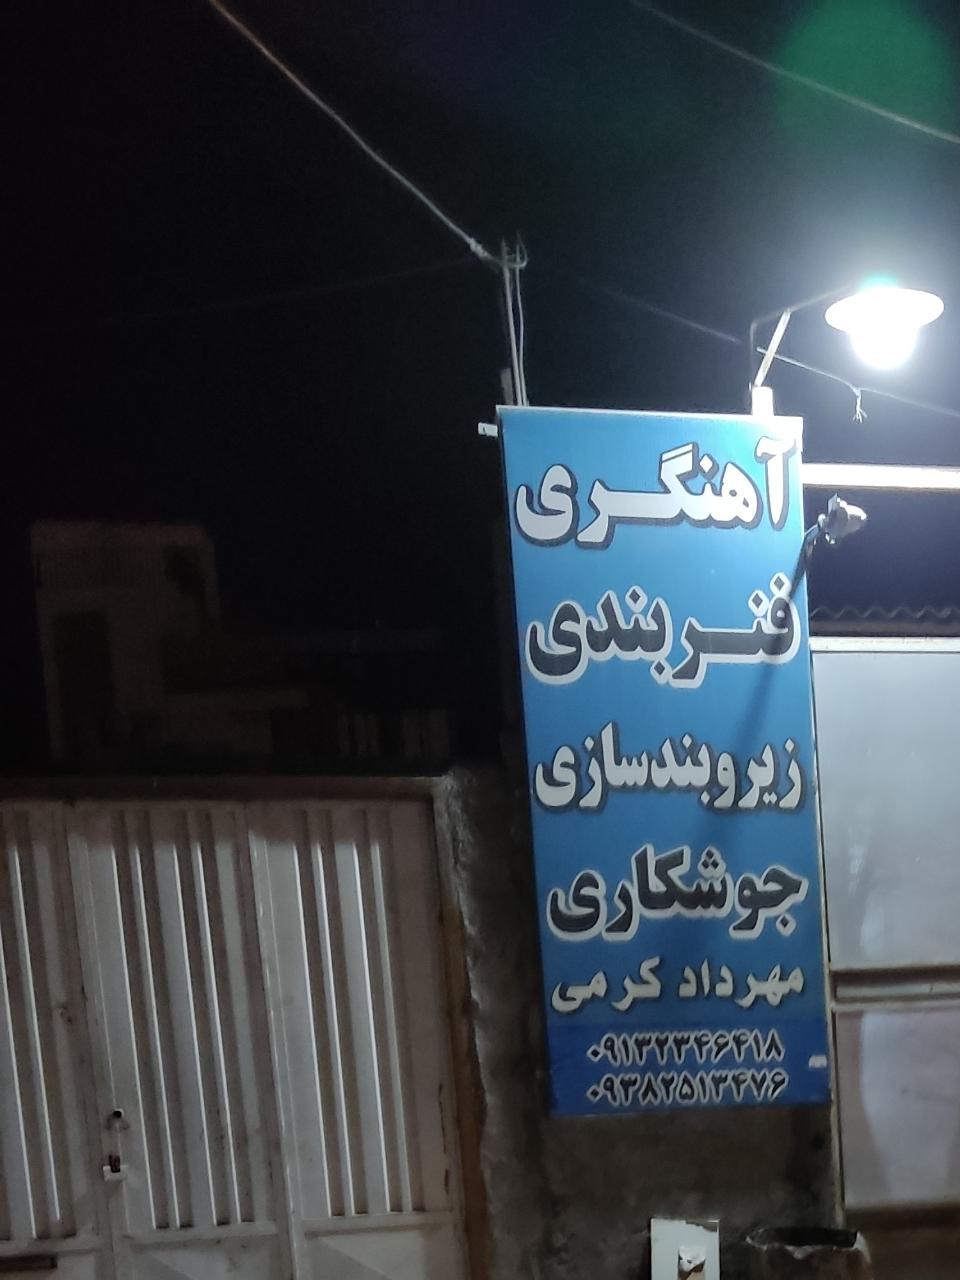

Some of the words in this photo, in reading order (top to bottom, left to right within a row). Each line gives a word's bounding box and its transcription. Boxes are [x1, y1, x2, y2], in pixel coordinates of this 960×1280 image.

[515, 435, 799, 547] آهنگری
[546, 843, 807, 941] جوشکاری
[551, 954, 662, 1014] کرمی
[673, 957, 805, 1008] مهرداد
[586, 1028, 786, 1067] ۰۹۱۳۲۳۴۶۴۱۸
[586, 1068, 790, 1107] ۰۹۳۸۲۵۱۳۴۷۶
